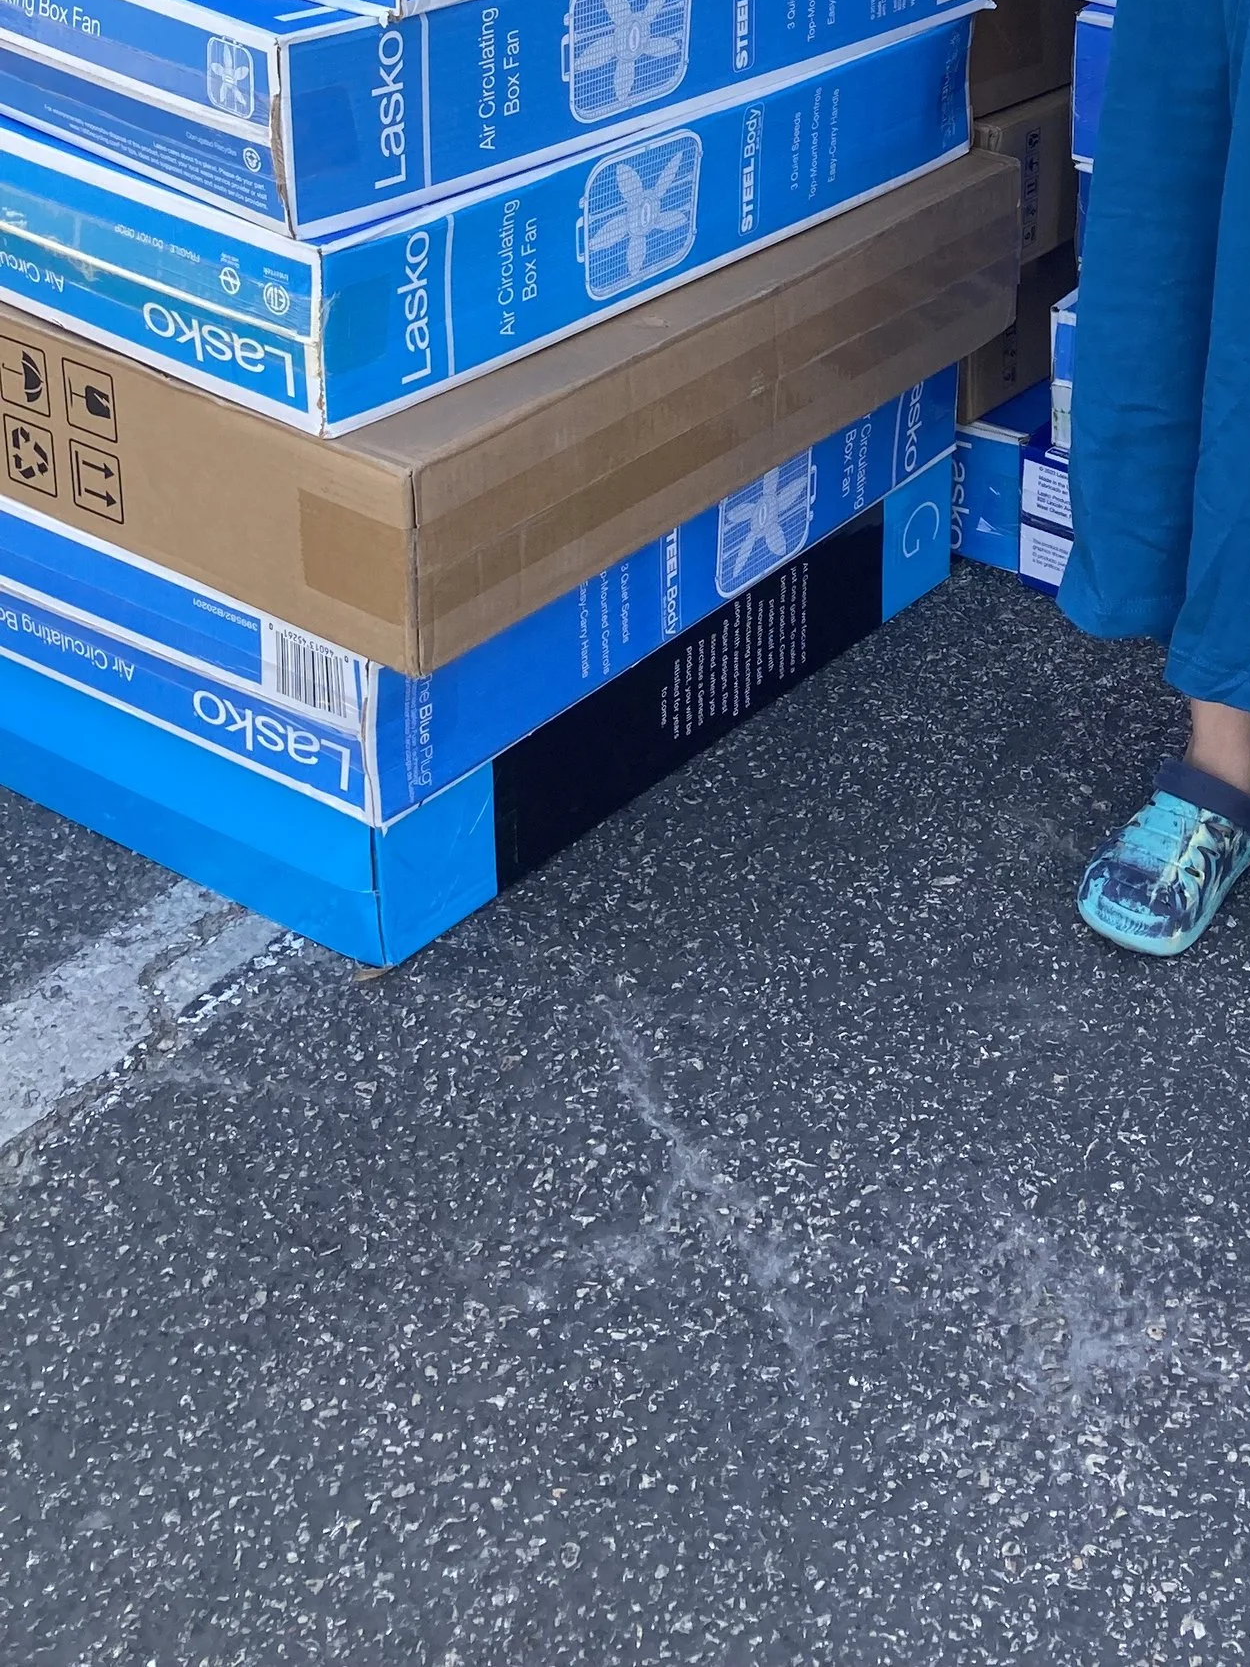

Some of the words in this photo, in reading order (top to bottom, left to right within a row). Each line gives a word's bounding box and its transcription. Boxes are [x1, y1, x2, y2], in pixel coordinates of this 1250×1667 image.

[72, 7, 101, 37] Fan
[478, 7, 499, 119] Circulating
[503, 29, 520, 69] Fan
[372, 31, 406, 189] Lasko
[503, 73, 520, 116] Box
[479, 125, 496, 150] Air
[397, 231, 431, 384] Lasko
[142, 302, 296, 398] Lasko
[193, 597, 259, 632] 399582/B20201
[800, 610, 807, 625] we
[22, 613, 109, 672] Circulating
[800, 626, 808, 650] focus
[112, 657, 135, 683] Air
[193, 690, 352, 792] Lasko
